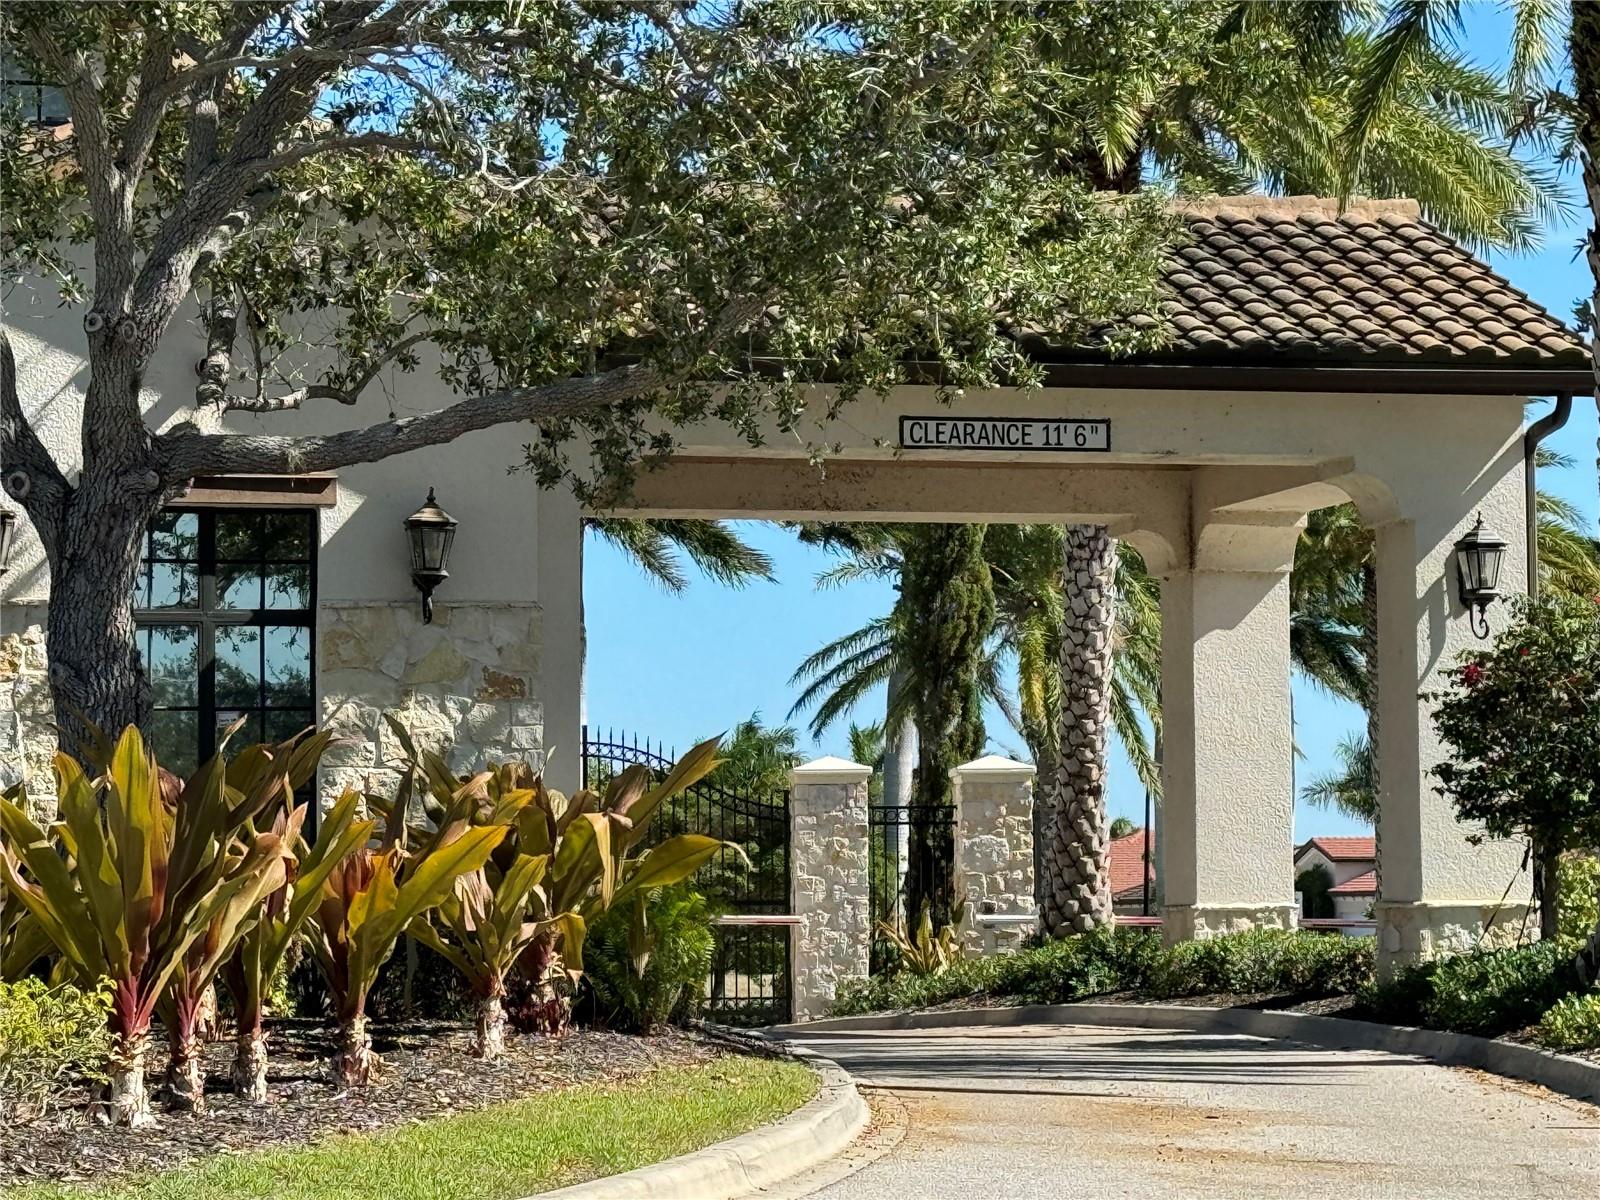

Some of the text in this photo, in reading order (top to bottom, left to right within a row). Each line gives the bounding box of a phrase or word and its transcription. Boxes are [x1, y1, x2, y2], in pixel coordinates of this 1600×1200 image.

[909, 421, 1099, 447] CLEARANCE 11' 6"
